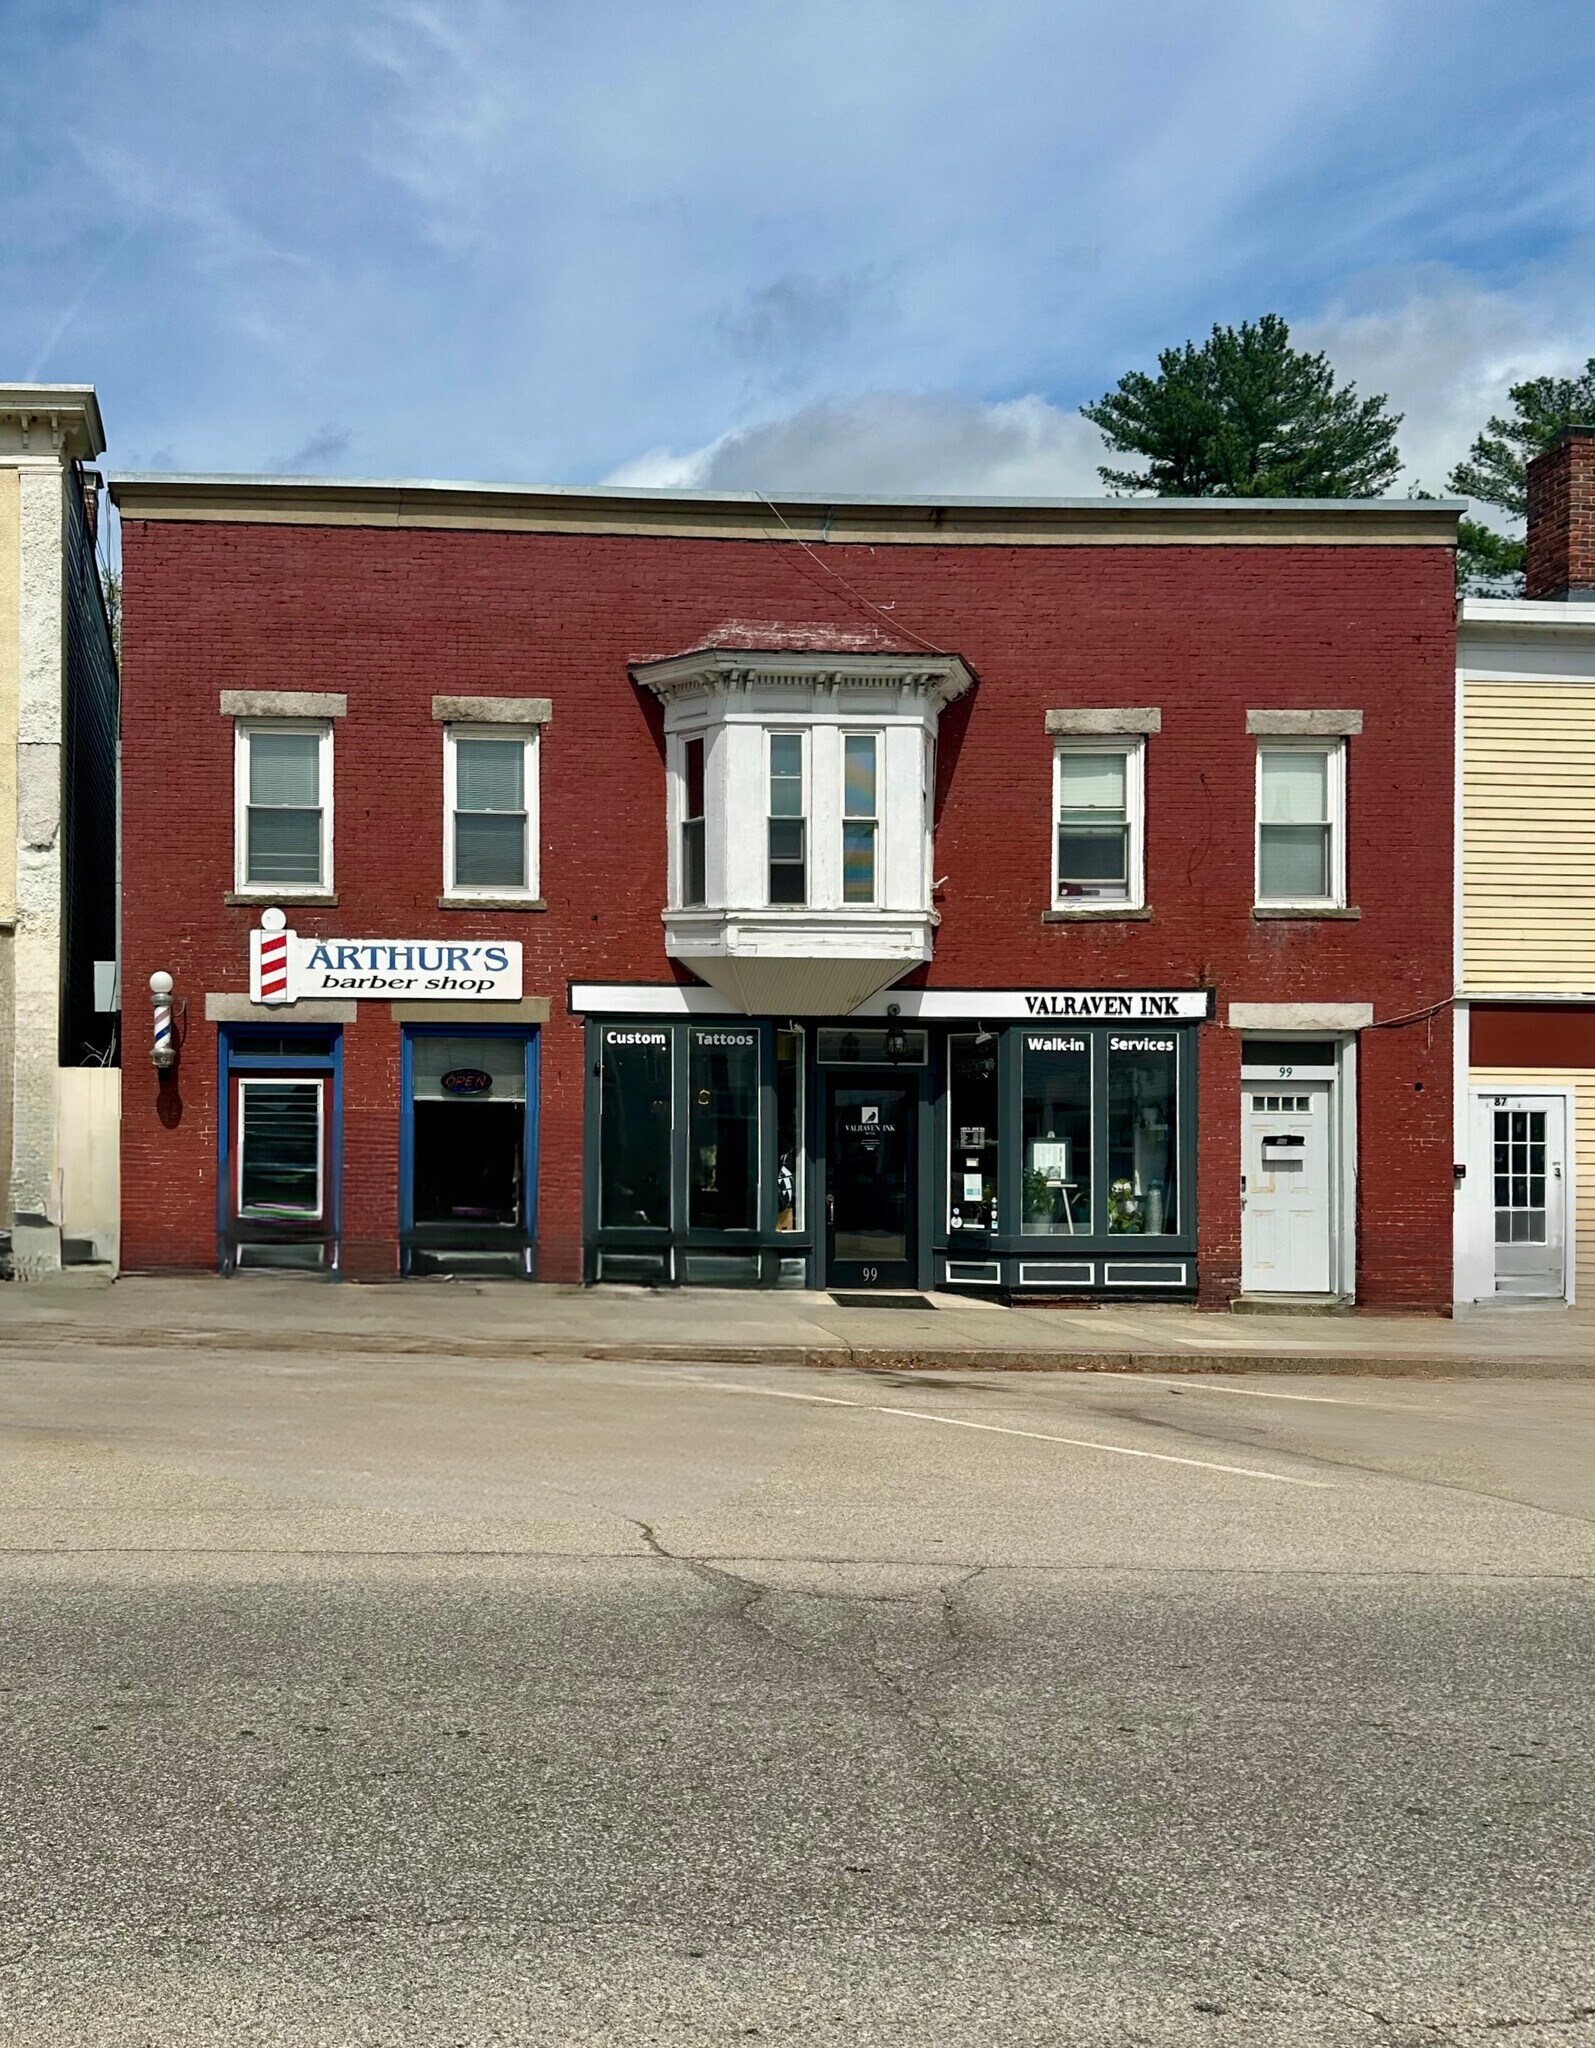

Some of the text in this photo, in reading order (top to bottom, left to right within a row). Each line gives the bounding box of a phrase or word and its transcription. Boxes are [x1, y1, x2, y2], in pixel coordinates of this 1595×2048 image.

[306, 945, 509, 972] ARTHUR'S
[321, 975, 495, 994] barber shop
[1025, 996, 1180, 1016] VALRAVEN INK
[606, 1031, 754, 1045] Custom Tattoos
[1028, 1037, 1174, 1051] Walk-in Services
[1279, 1066, 1293, 1078] 99
[445, 1074, 487, 1087] OPEN
[1494, 1097, 1507, 1106] 87
[862, 1267, 878, 1281] 99
